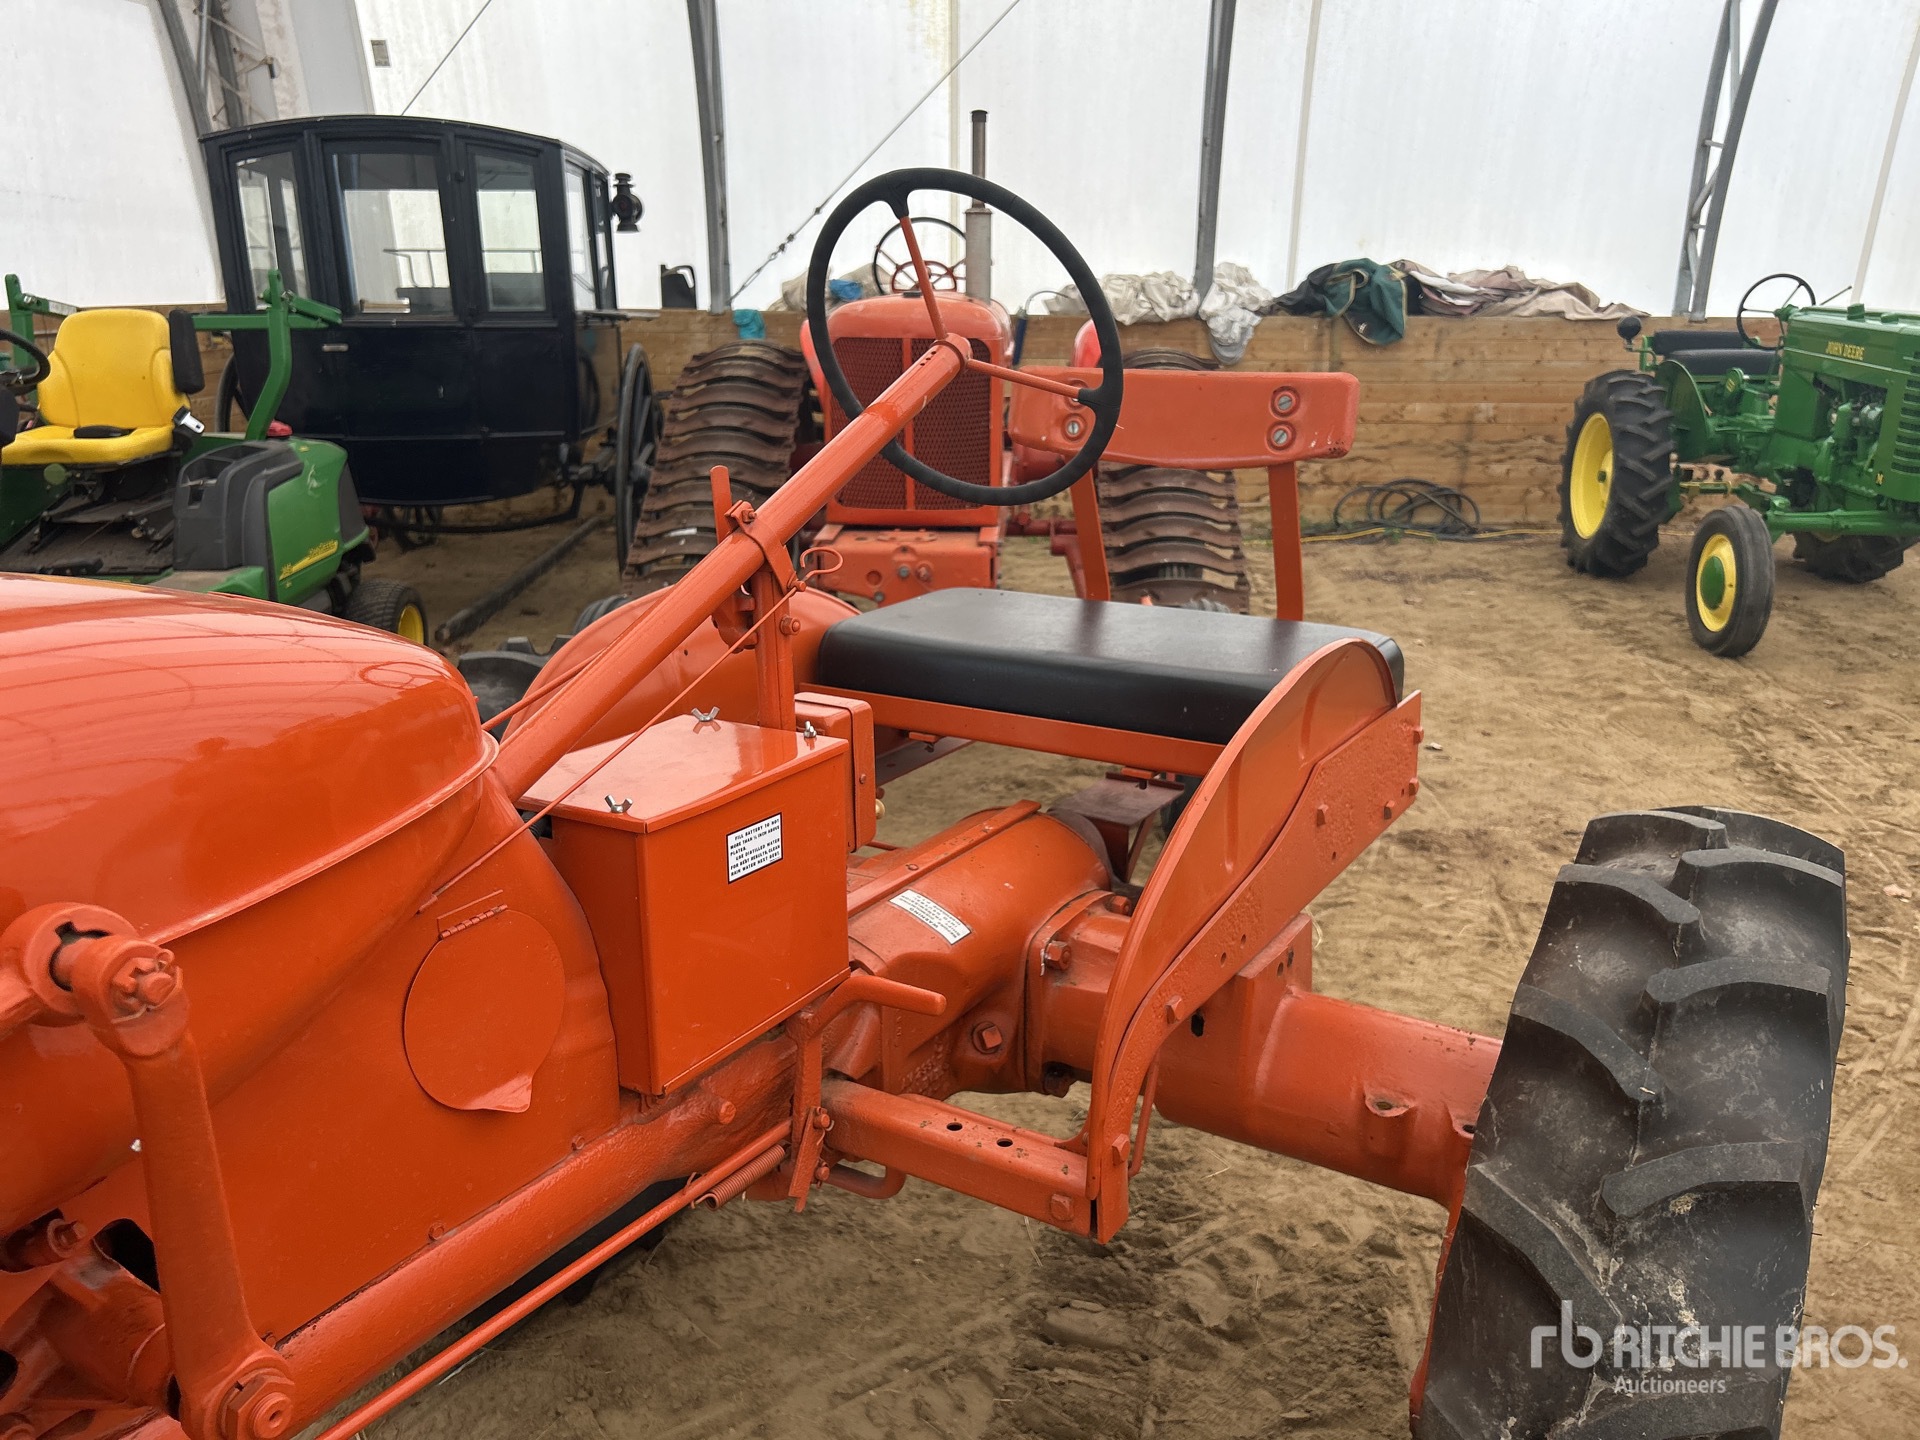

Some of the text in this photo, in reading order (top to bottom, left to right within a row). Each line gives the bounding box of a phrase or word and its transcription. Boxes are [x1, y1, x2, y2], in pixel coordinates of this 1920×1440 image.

[1825, 341, 1865, 361] JOHN DEERE
[745, 826, 763, 836] BATTERY
[768, 825, 779, 833] ABOVE
[740, 858, 750, 866] BEST
[768, 845, 780, 853] CLEAN
[745, 844, 765, 856] DISTILLED
[767, 838, 779, 846] WATER
[742, 862, 756, 871] WATER
[909, 907, 938, 928] WARNING
